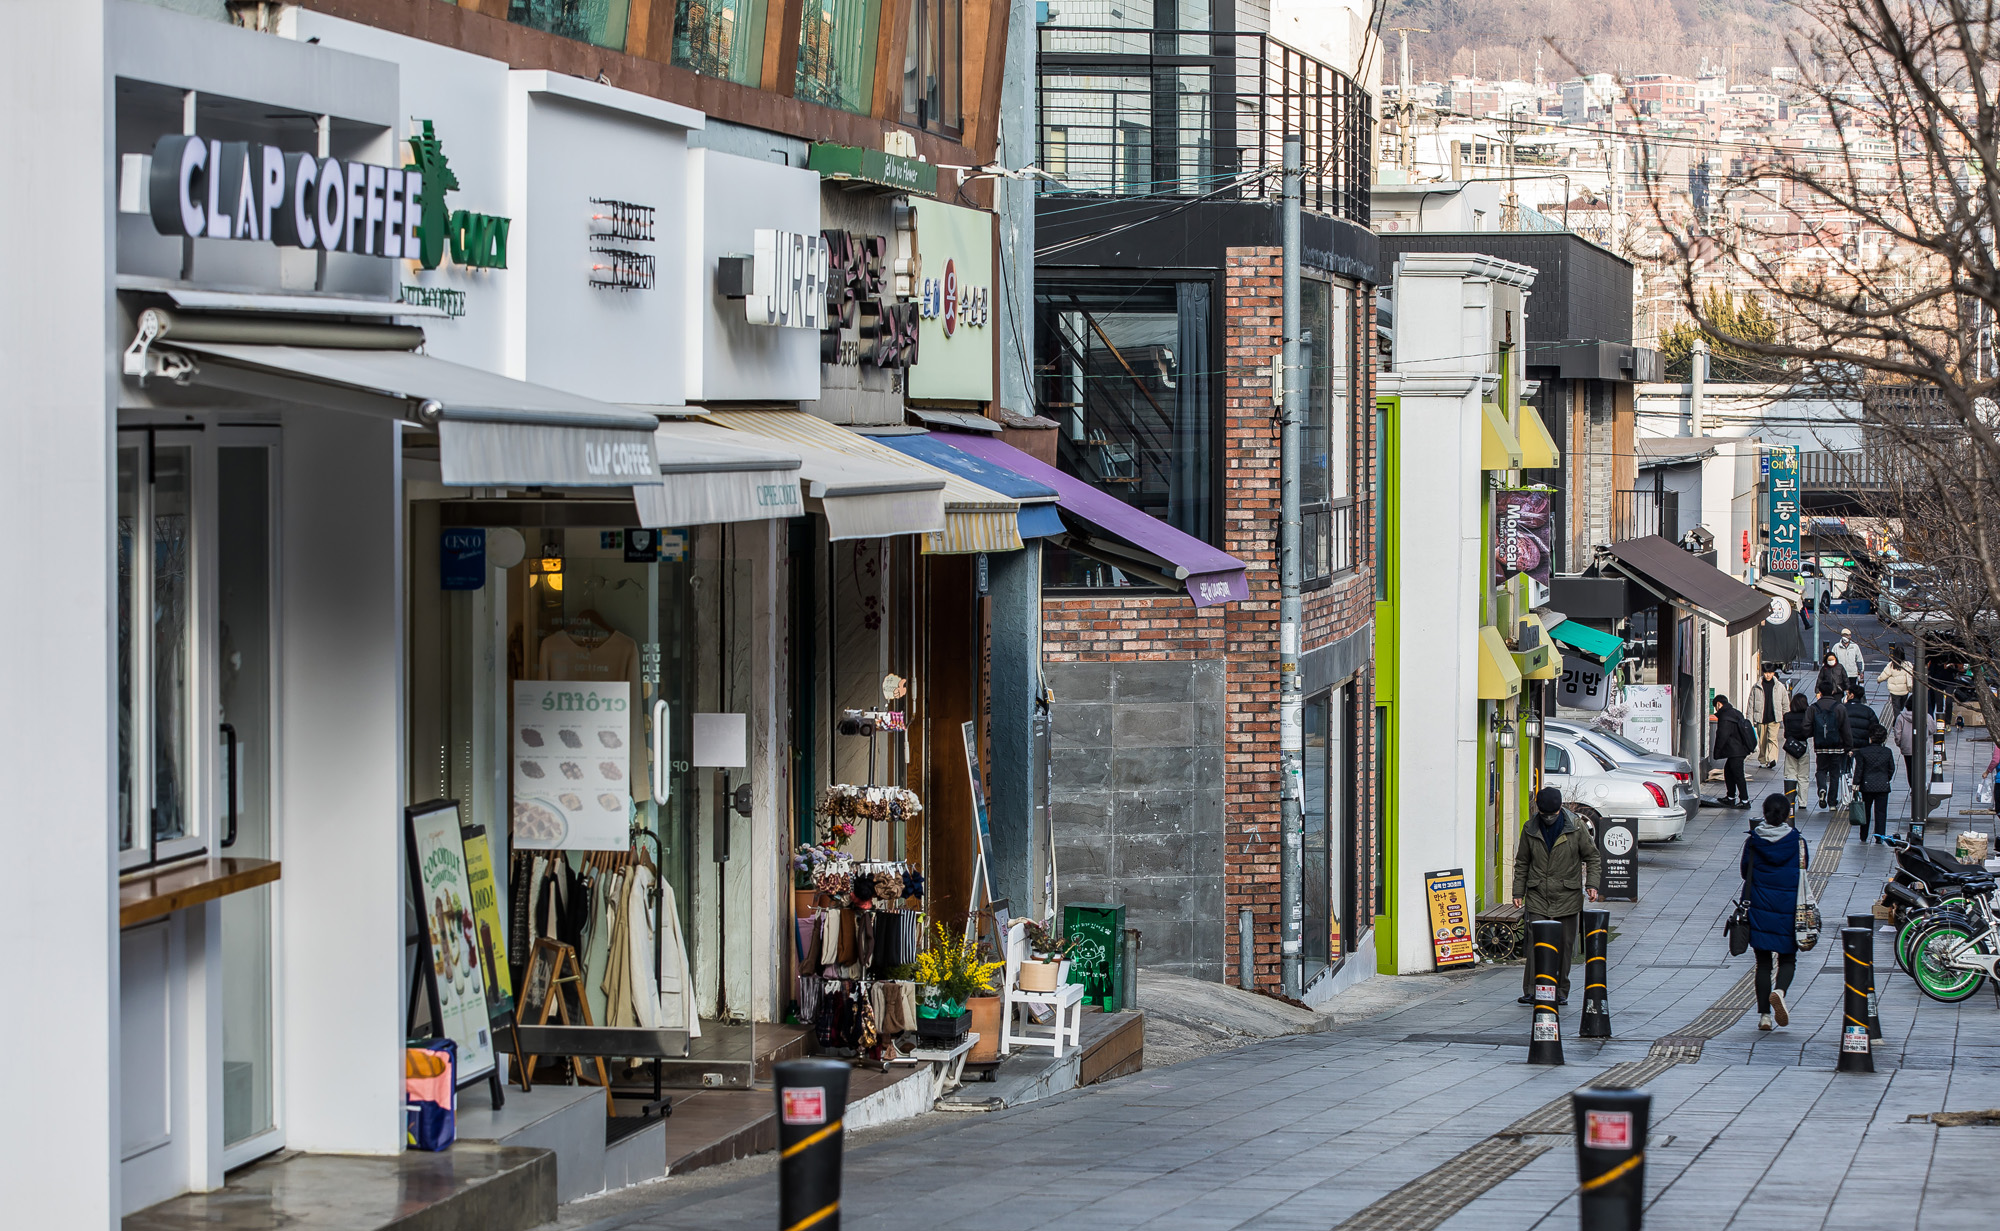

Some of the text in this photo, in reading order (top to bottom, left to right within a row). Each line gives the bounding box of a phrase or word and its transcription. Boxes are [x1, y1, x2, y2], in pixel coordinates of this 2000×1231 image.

[178, 134, 423, 259] CLAP COFFEE
[608, 200, 656, 242] BARBIE
[608, 249, 656, 290] RIBBON
[585, 441, 653, 475] CLAP COFFEE
[1773, 477, 1798, 544] 부동산
[445, 535, 482, 548] CESCO
[1506, 504, 1521, 571] Monceau
[1771, 547, 1798, 559] 714-
[1771, 559, 1799, 572] 6066
[1562, 669, 1602, 696] 김밥
